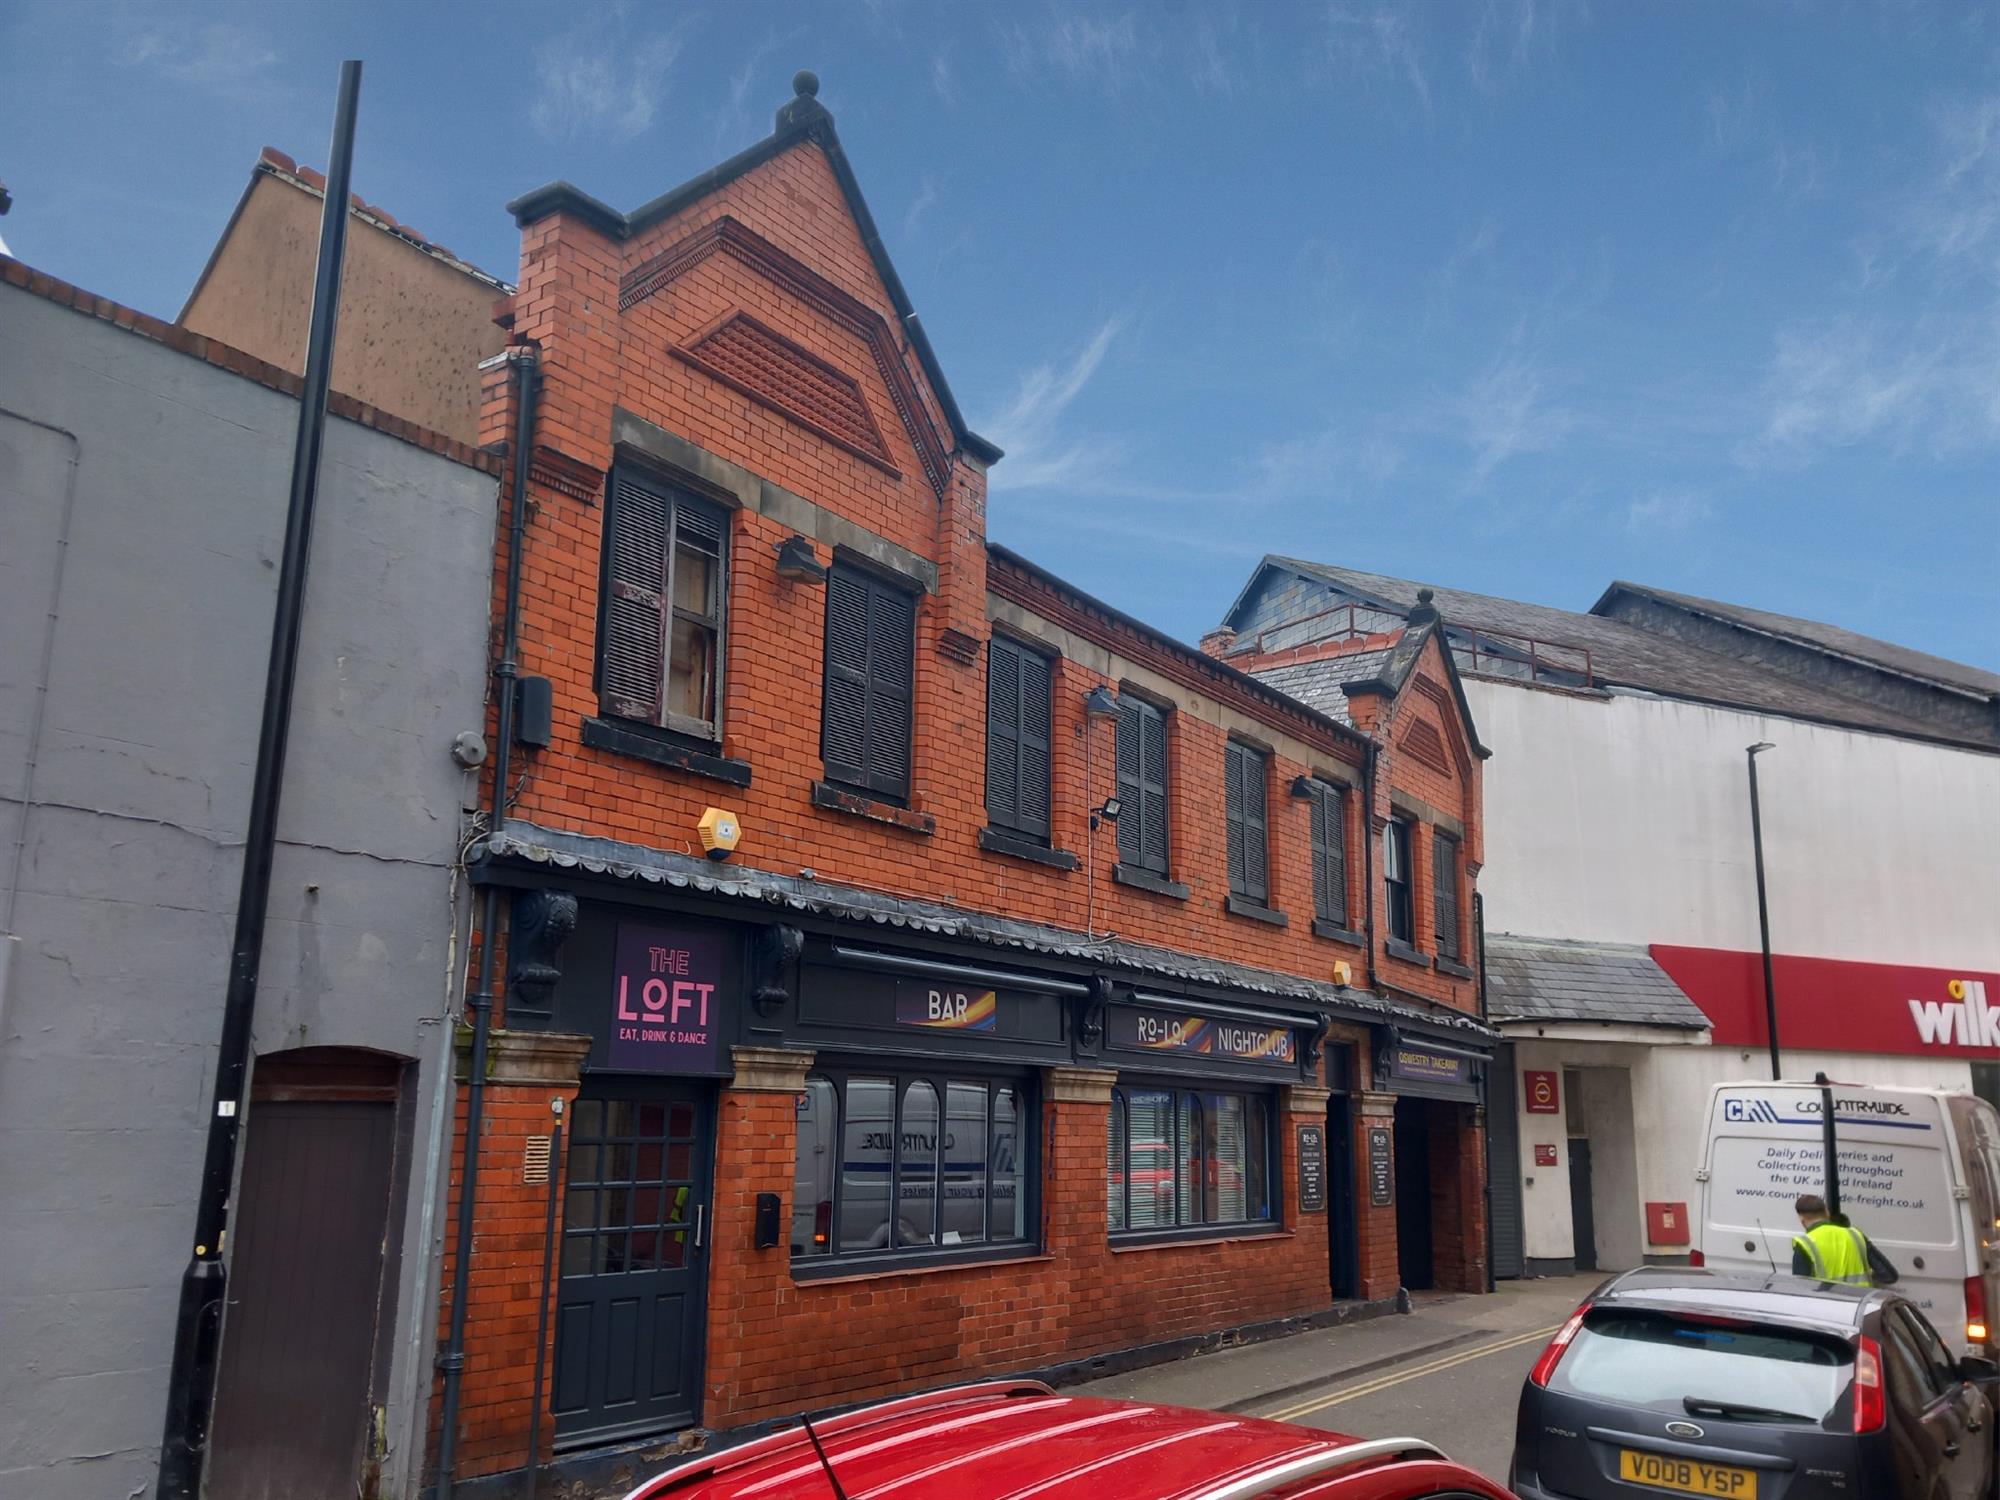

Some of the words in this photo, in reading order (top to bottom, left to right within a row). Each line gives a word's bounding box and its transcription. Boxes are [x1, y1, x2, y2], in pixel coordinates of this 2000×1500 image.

[648, 946, 690, 976] THE
[618, 975, 715, 1026] LOFT
[928, 990, 968, 1023] BAR
[619, 1028, 640, 1042] EAT,
[641, 1029, 667, 1042] DRINK
[669, 1031, 676, 1043] &
[677, 1031, 707, 1045] DANCE
[1217, 1027, 1288, 1057] NIGHTCLUB
[1757, 1159, 1822, 1173] Collections
[1838, 1162, 1904, 1178] throughout
[1766, 1147, 1796, 1160] Daily
[1871, 1153, 1894, 1163] and
[1770, 1173, 1789, 1184] the
[1793, 1175, 1810, 1185] UK
[1852, 1178, 1893, 1190] Ireland
[1632, 1454, 1691, 1486] VO08
[1699, 1466, 1745, 1494] YSP
